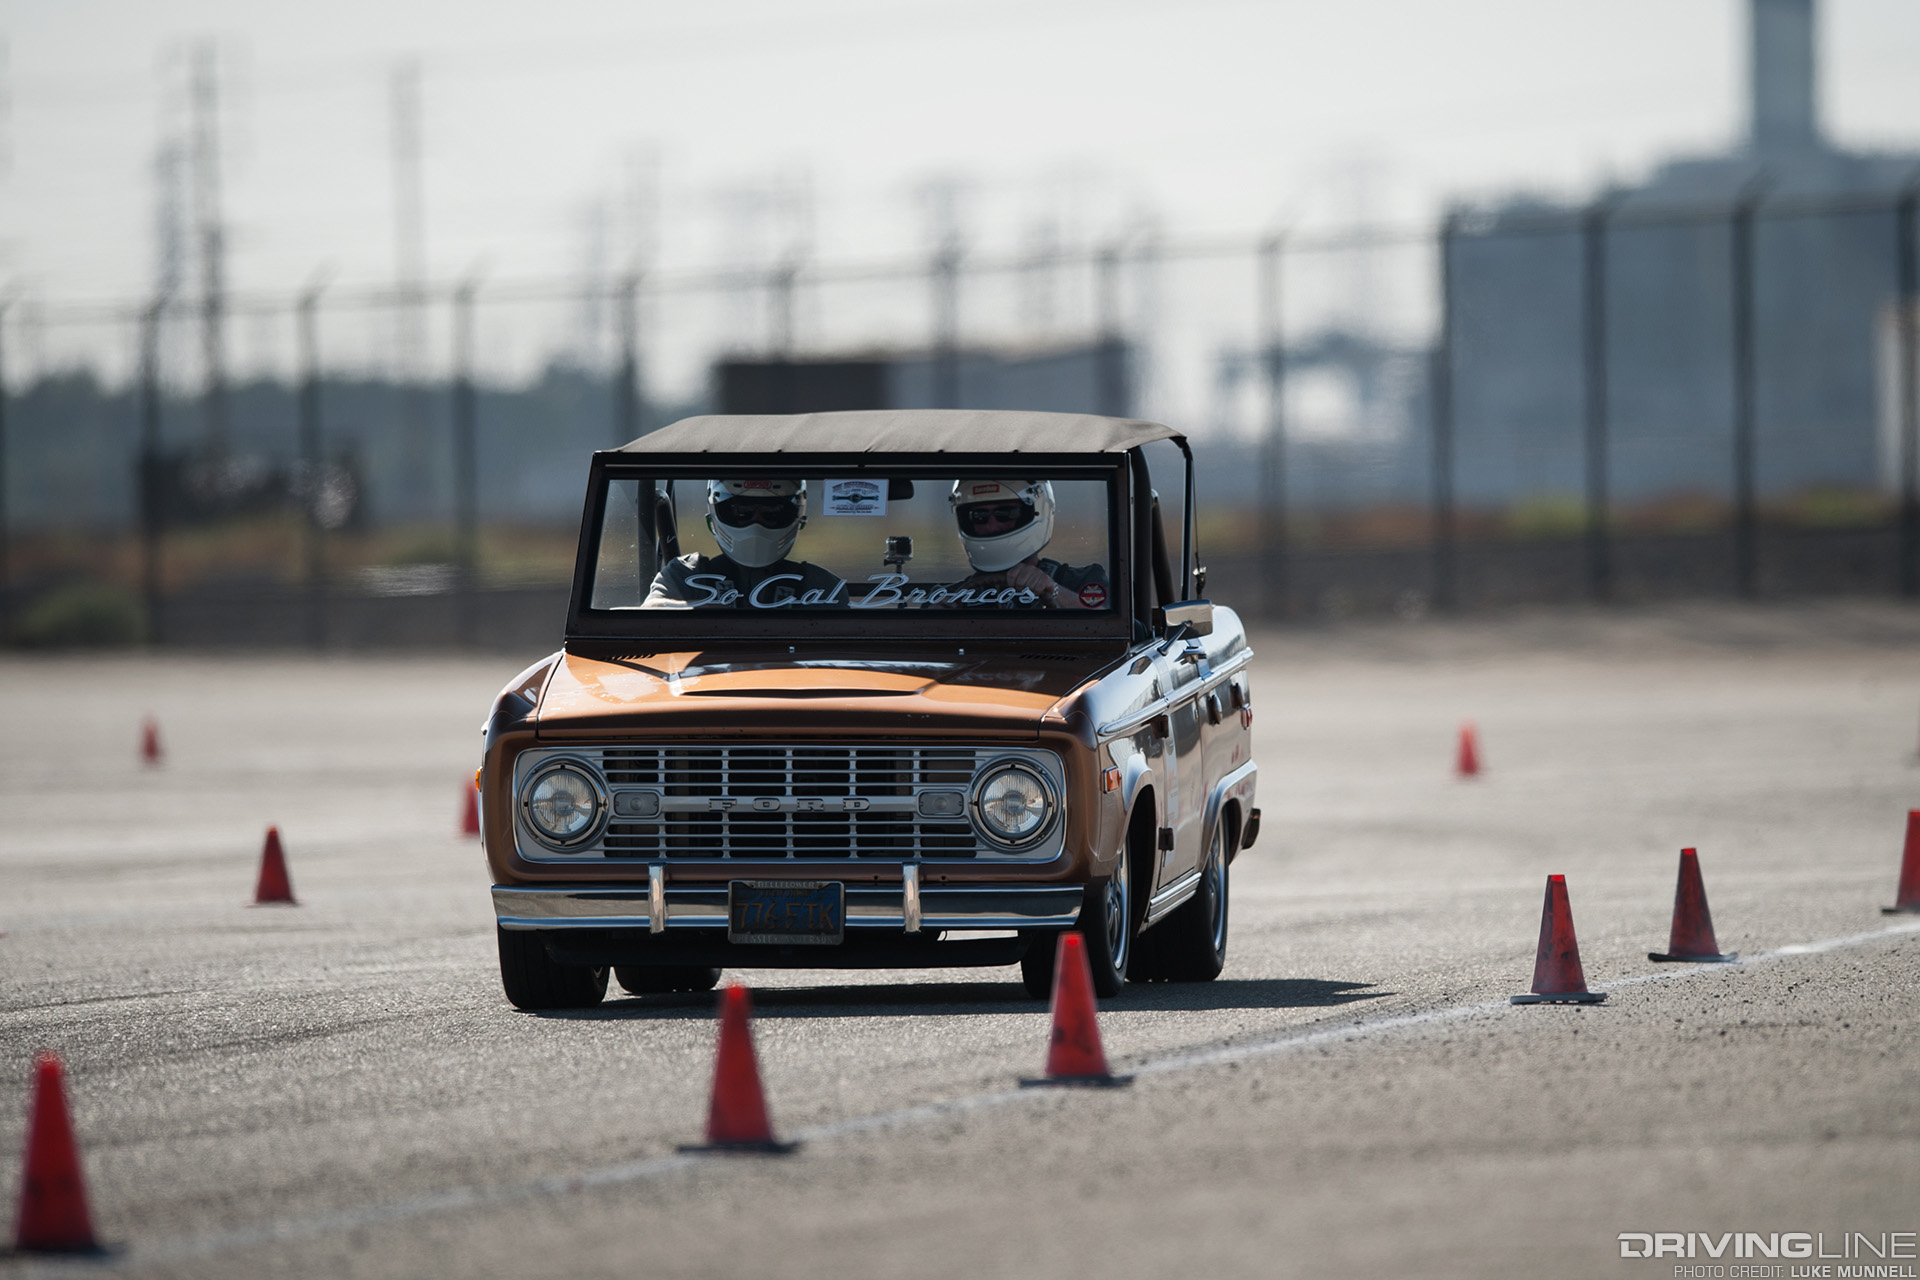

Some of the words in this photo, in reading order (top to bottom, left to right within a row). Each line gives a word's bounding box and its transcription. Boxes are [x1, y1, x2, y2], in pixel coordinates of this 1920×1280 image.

[684, 573, 744, 608] So
[749, 573, 848, 608] Cal
[849, 573, 1039, 608] Broncos
[709, 798, 870, 812] FORD
[786, 903, 835, 929] FTK
